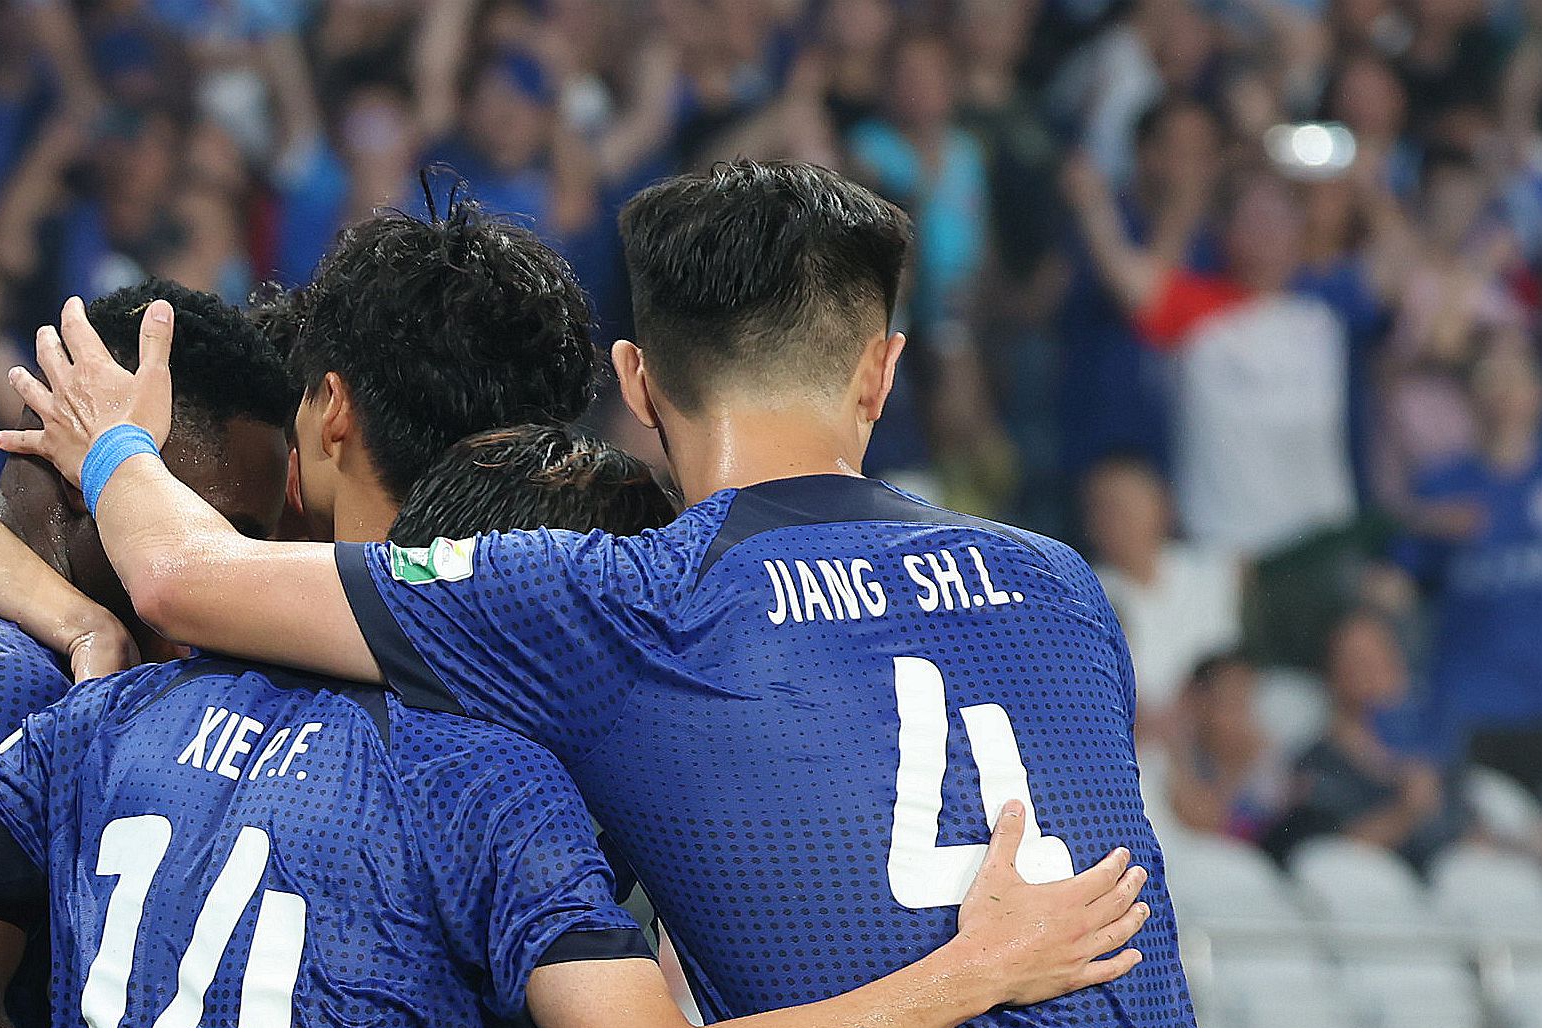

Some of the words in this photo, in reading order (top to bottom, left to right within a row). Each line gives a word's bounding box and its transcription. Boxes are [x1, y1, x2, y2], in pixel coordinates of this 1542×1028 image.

[762, 558, 888, 625] JIANG
[902, 546, 1025, 613] SH.L.
[177, 706, 265, 781] XIE
[248, 722, 323, 781] P.F.
[887, 656, 1075, 909] 4
